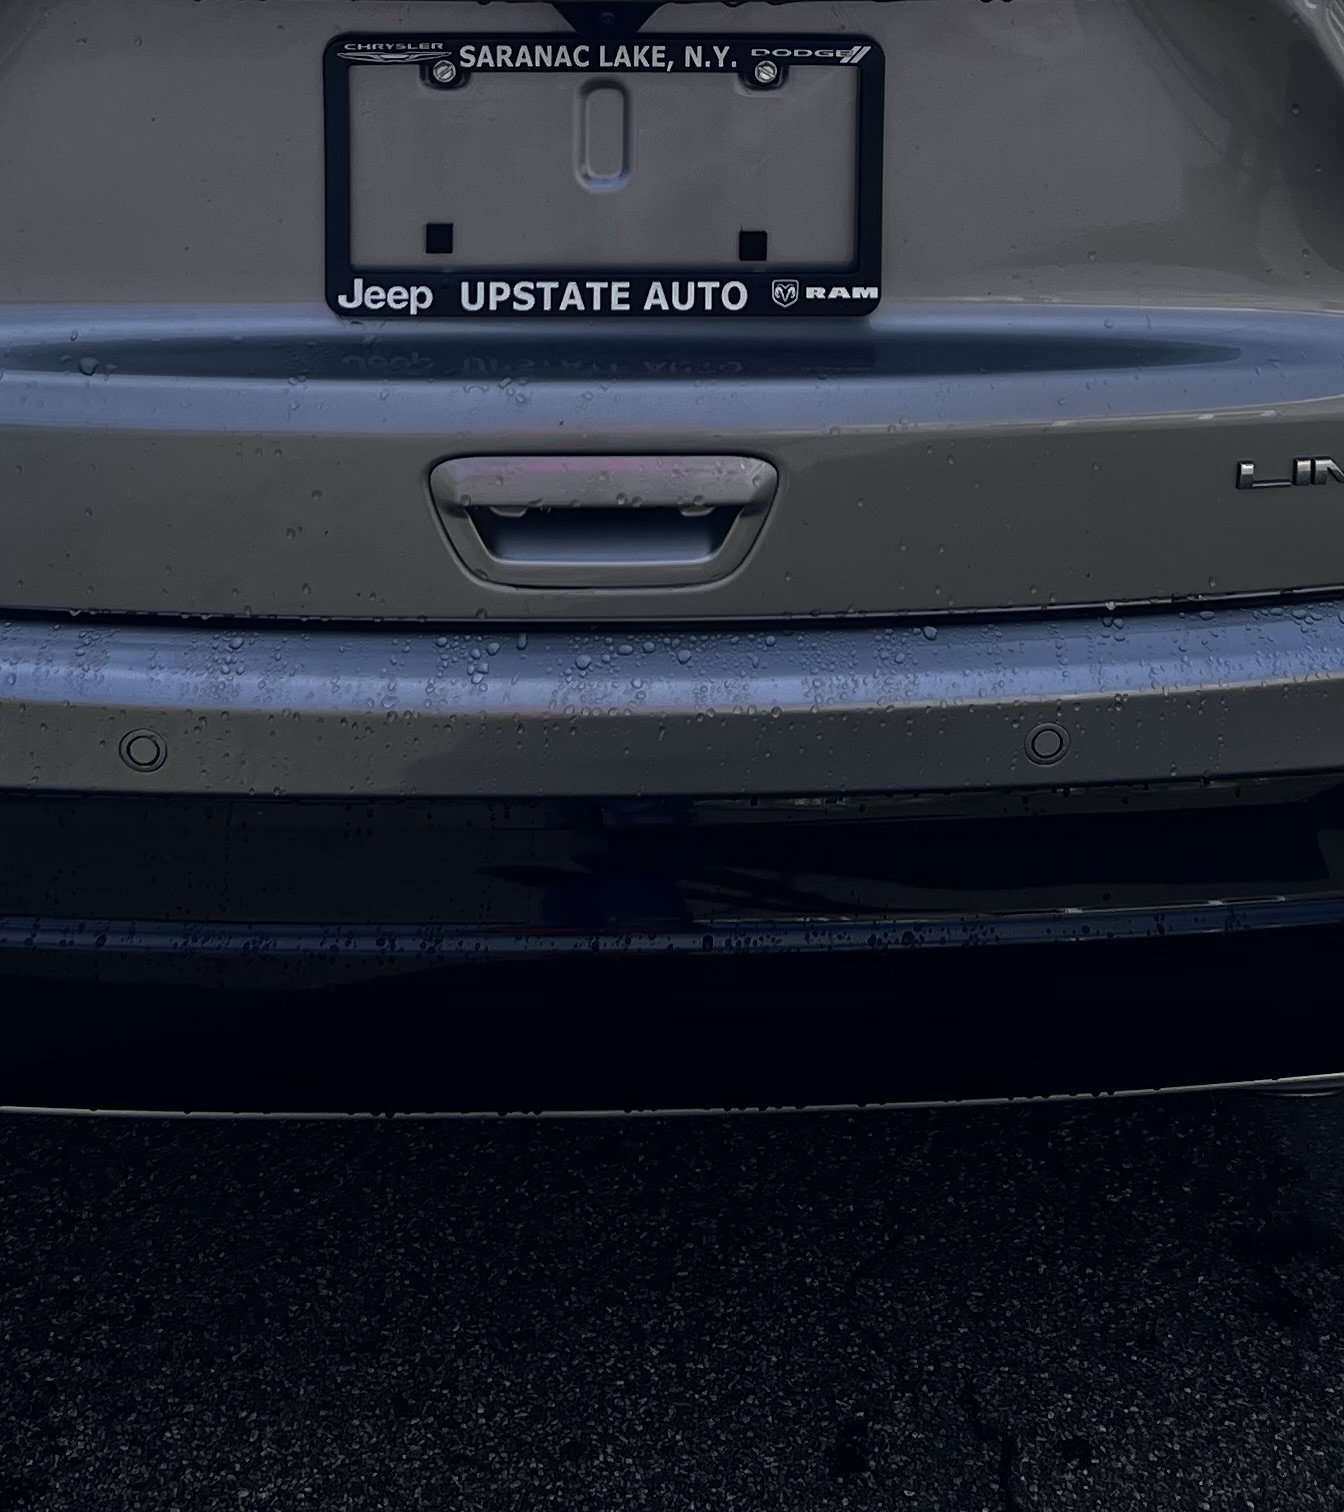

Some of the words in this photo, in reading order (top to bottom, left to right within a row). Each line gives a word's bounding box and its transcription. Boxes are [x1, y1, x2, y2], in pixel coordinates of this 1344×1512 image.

[344, 42, 444, 51] CHRYSLER
[751, 47, 857, 58] DODGE
[459, 44, 590, 68] SARANAC
[599, 45, 674, 72] LAKE,
[684, 45, 737, 68] N.Y.
[338, 278, 433, 315] Jeep
[461, 281, 630, 311] UPSTATE
[643, 280, 748, 311] AUTO
[806, 287, 878, 299] RAM
